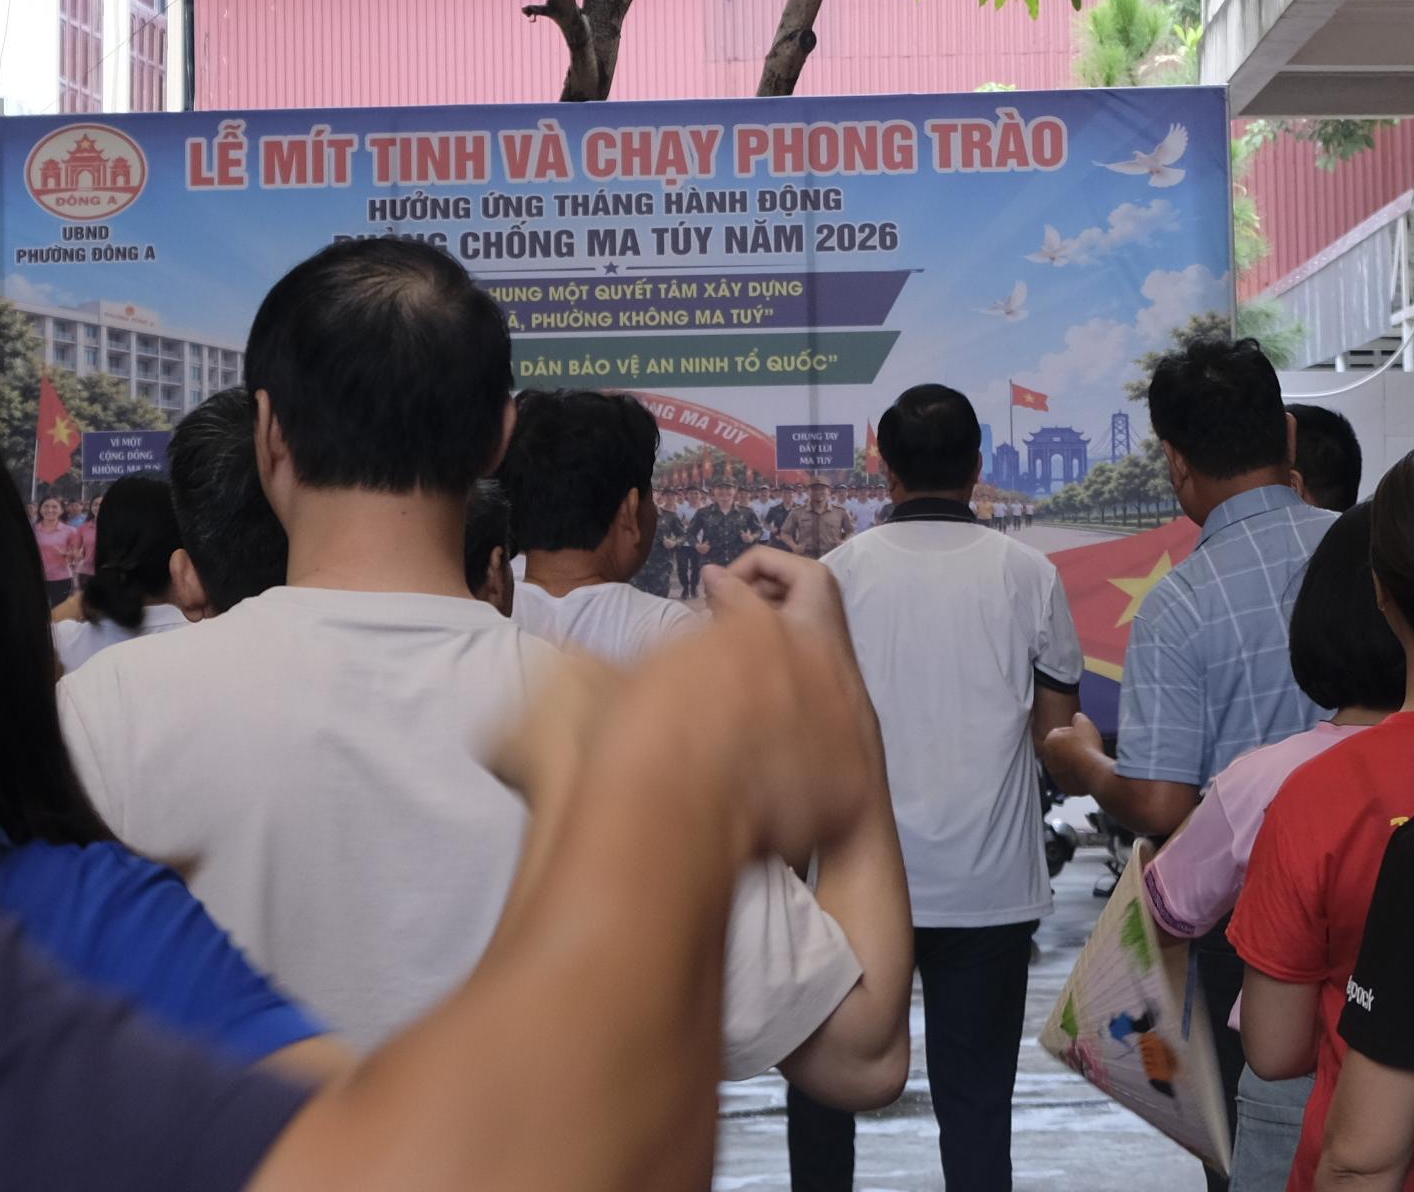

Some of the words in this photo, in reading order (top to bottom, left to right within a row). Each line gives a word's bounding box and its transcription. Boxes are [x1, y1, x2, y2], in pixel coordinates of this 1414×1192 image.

[187, 121, 246, 189] LỄ
[261, 127, 356, 186] MÍT
[367, 133, 487, 184] TINH
[500, 121, 570, 181] VÀ
[584, 127, 721, 187] CHẠY
[735, 121, 916, 176] PHONG
[928, 110, 1065, 170] TRÀO
[107, 195, 118, 206] A
[367, 190, 471, 221] HƯỞNG
[481, 190, 544, 219] ỨNG
[553, 188, 654, 217] THÁNG
[664, 186, 747, 215] HÀNH
[757, 184, 842, 217] ĐỘNG
[61, 225, 109, 242] UBND
[459, 220, 575, 259] CHỐNG
[586, 228, 641, 257] MA
[651, 220, 713, 256] TÚY
[724, 218, 804, 254] NĂM
[815, 222, 899, 253] 2026
[15, 244, 86, 264] PHƯỜNG
[91, 244, 139, 262] ĐÔNG
[144, 245, 156, 261] A
[489, 285, 543, 302] HUNG
[548, 281, 590, 305] MỘT
[594, 278, 654, 301] QUYẾT
[658, 279, 698, 299] TÂM
[703, 277, 742, 298] XÂY
[747, 279, 804, 301] DỰNG
[531, 308, 613, 329] PHƯỜNG
[619, 306, 689, 327] KHÔNG
[695, 309, 725, 325] MA
[519, 356, 562, 377] DÂN
[568, 354, 611, 376] BẢO
[616, 354, 640, 379] VỆ
[645, 358, 674, 374] AN
[680, 357, 729, 374] NINH
[734, 347, 761, 373] TỔ
[678, 410, 711, 431] MA
[791, 432, 823, 441] CHUNG
[825, 432, 839, 441] TAY
